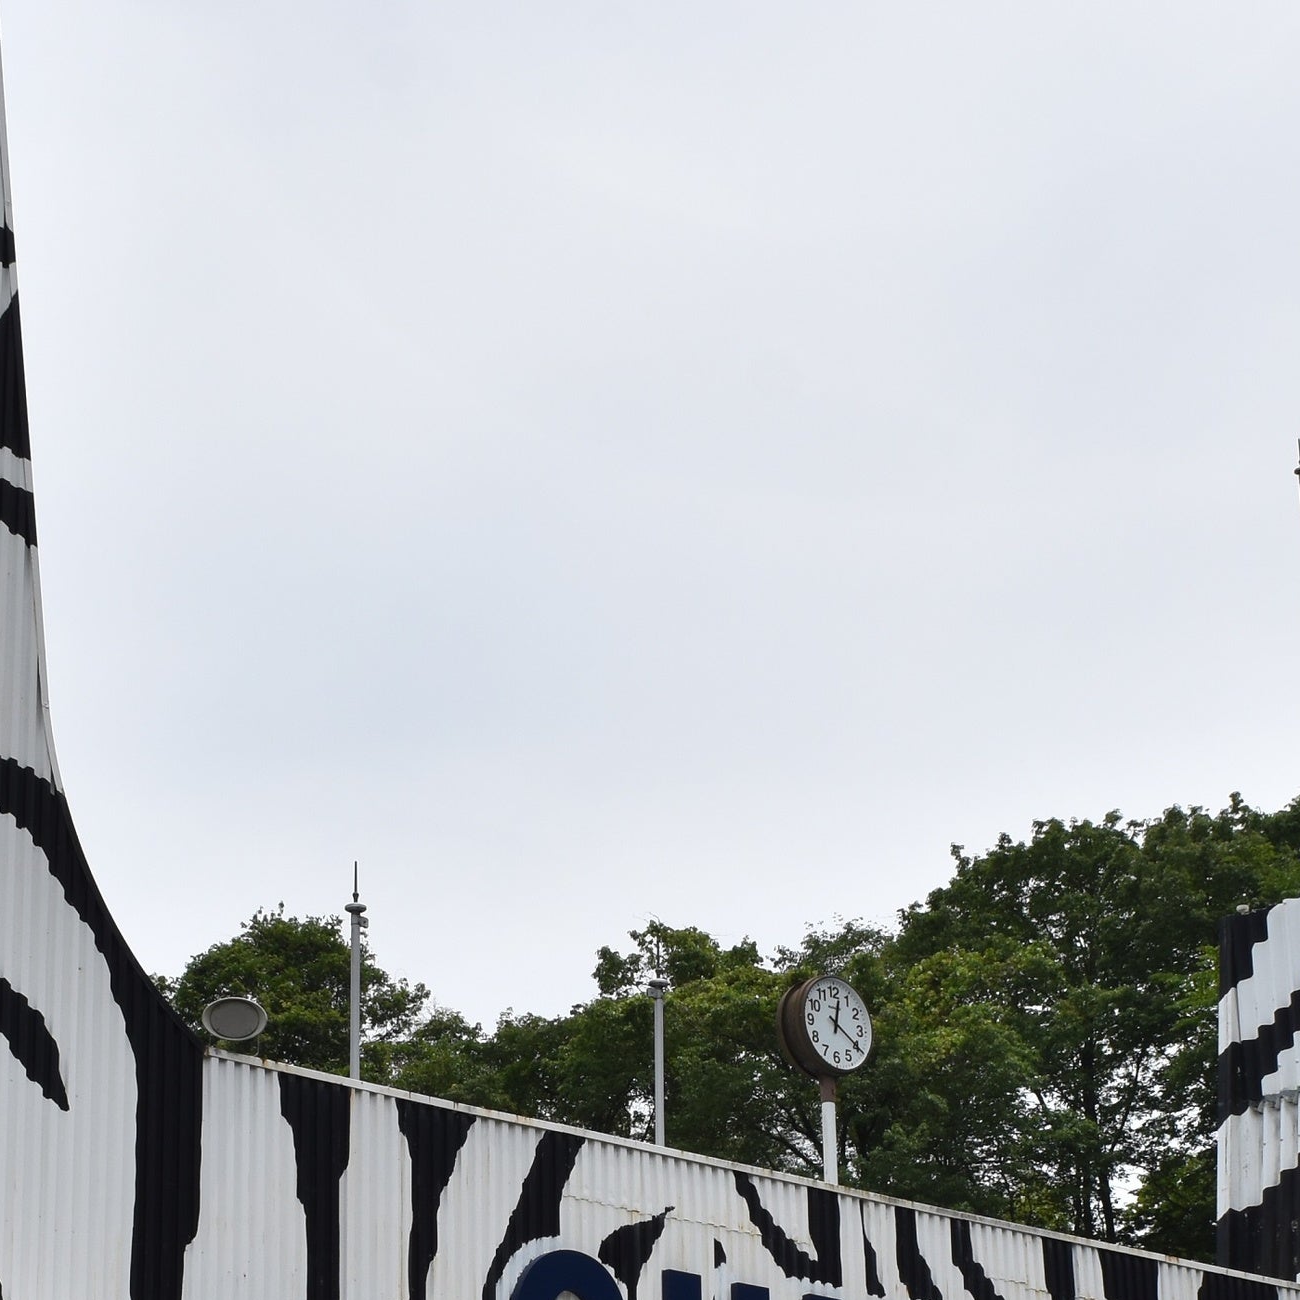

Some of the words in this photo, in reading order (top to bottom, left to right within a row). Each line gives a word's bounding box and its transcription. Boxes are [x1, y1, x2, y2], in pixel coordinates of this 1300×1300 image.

[816, 987, 827, 1001] 11
[828, 986, 840, 999] 12
[809, 998, 821, 1012] 10
[844, 995, 850, 1007] 1
[807, 1013, 814, 1025] 9
[852, 1008, 859, 1020] 2
[812, 1030, 819, 1043] 8
[856, 1025, 864, 1037] 3
[822, 1044, 829, 1056] 7
[853, 1040, 860, 1052] 4
[833, 1051, 840, 1063] 6
[845, 1049, 852, 1061] 5
